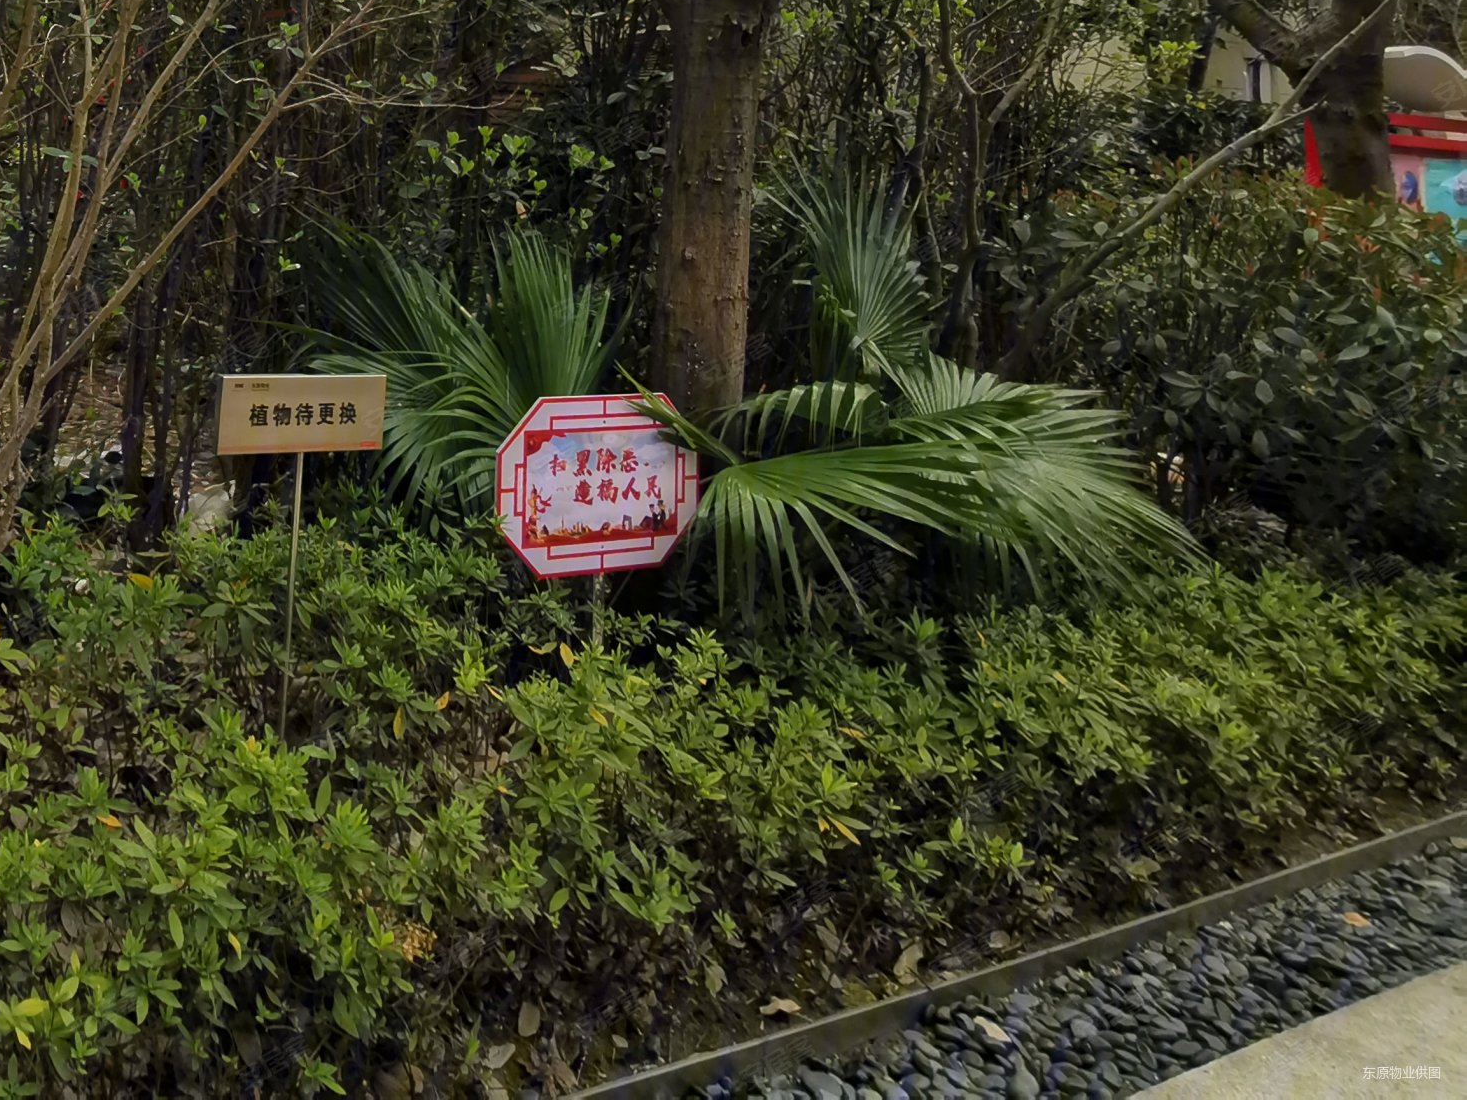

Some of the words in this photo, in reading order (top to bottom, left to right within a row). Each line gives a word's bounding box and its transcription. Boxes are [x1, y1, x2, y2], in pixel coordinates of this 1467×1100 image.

[249, 402, 357, 427] 植物待更换
[549, 447, 639, 477] 扫黑除恶
[573, 475, 662, 505] 造福人民
